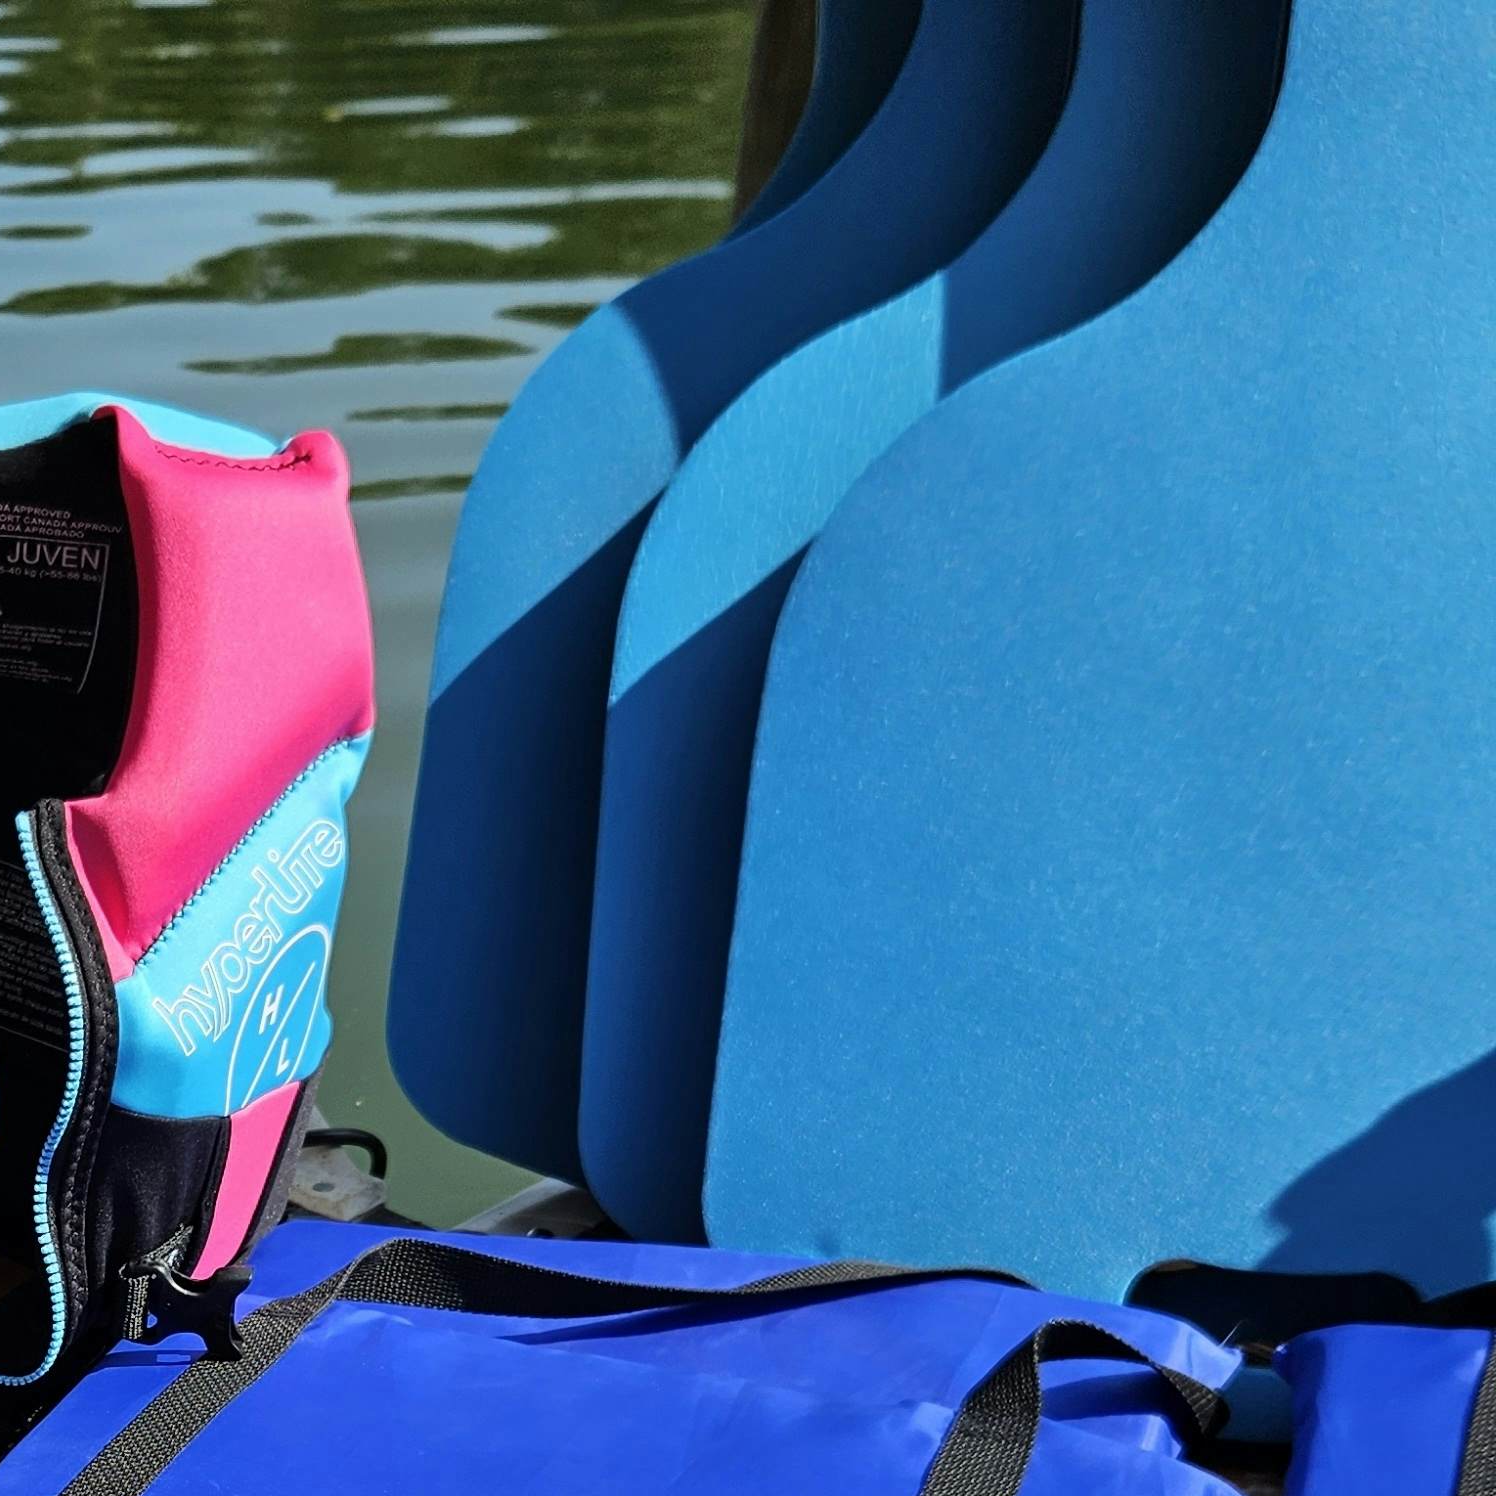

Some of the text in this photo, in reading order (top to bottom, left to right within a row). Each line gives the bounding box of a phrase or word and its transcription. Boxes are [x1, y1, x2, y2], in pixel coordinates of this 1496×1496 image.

[12, 505, 72, 520] APPROVED
[22, 516, 70, 530] CANADA
[71, 520, 122, 534] APPROUV
[23, 524, 85, 539] APROBADO
[6, 541, 101, 570] JUVEN
